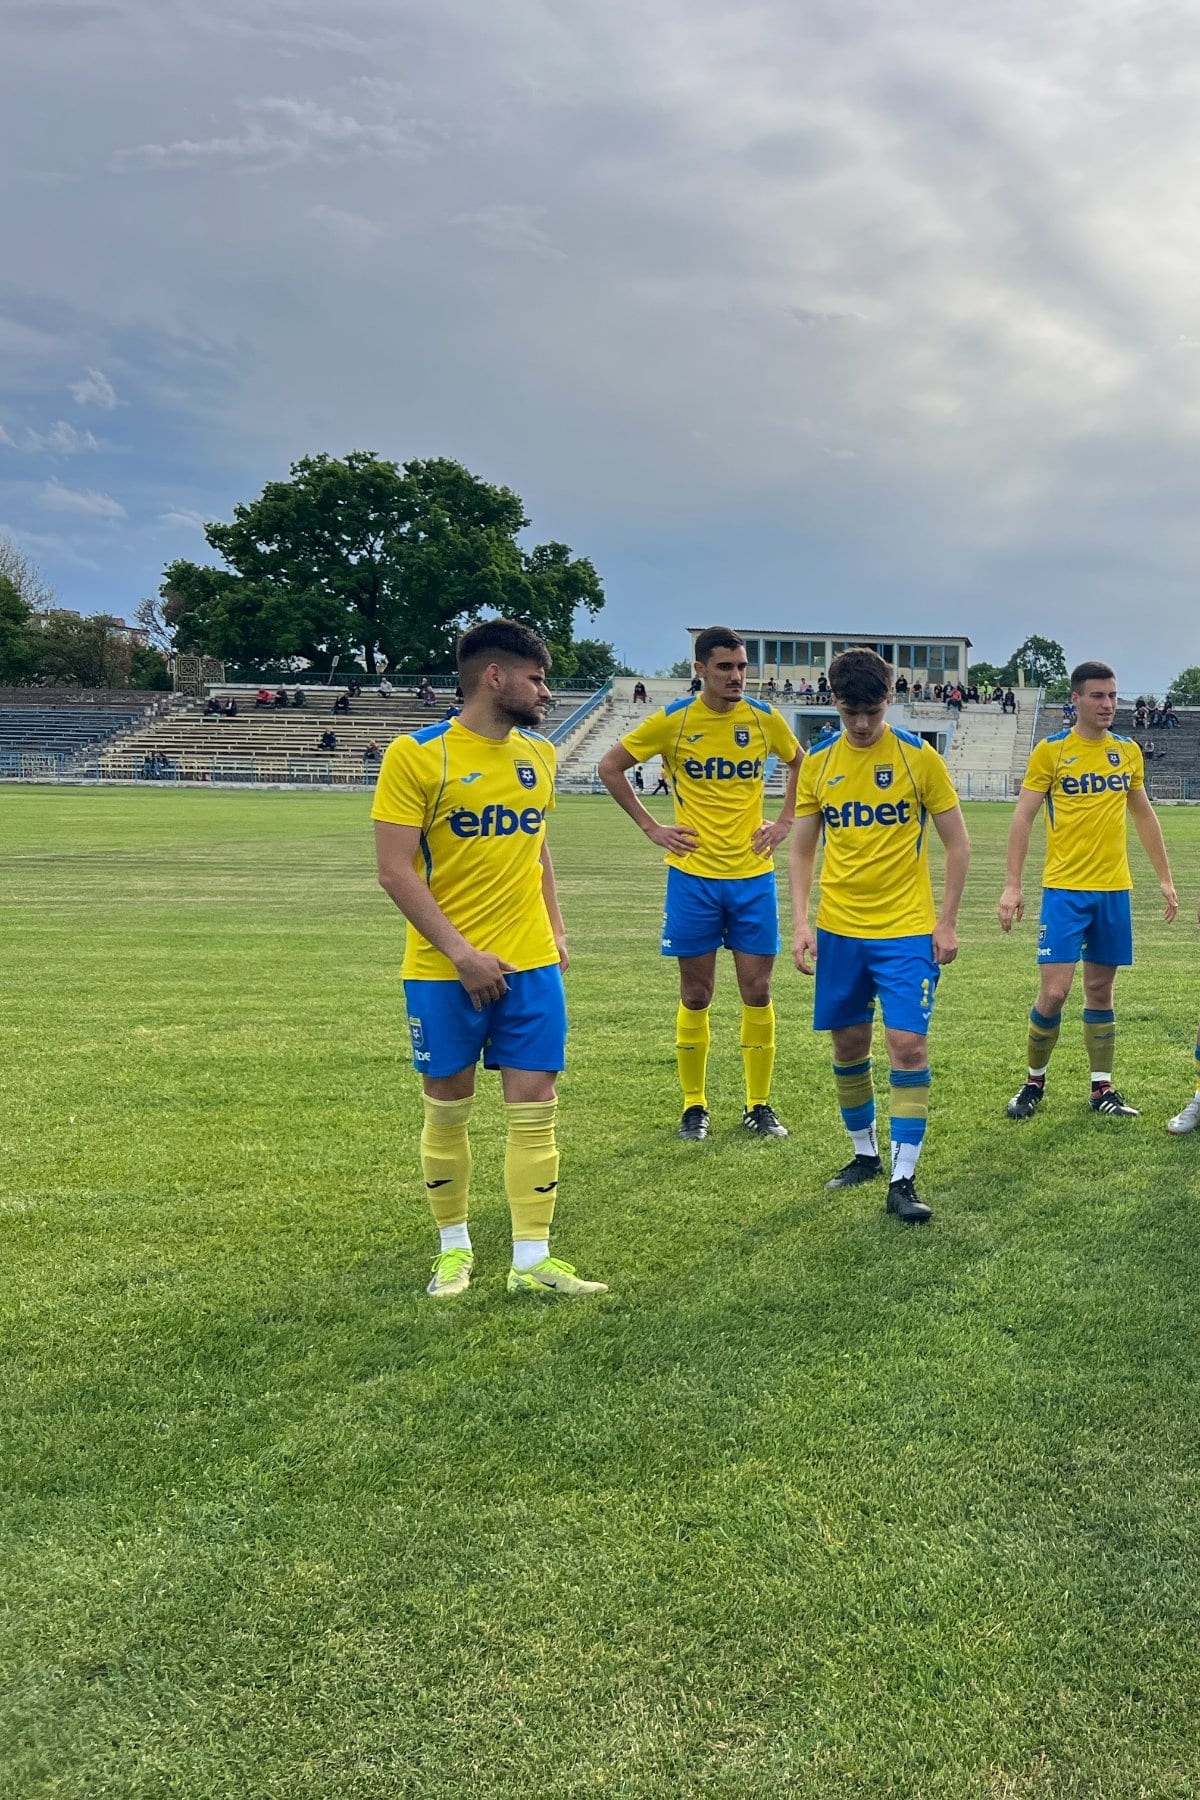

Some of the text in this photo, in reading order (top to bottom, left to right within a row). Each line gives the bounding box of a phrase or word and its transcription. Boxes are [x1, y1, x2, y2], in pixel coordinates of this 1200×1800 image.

[684, 757, 762, 780] efbet
[1062, 772, 1130, 795] efbet
[448, 804, 545, 837] efbe
[823, 799, 910, 828] efbet
